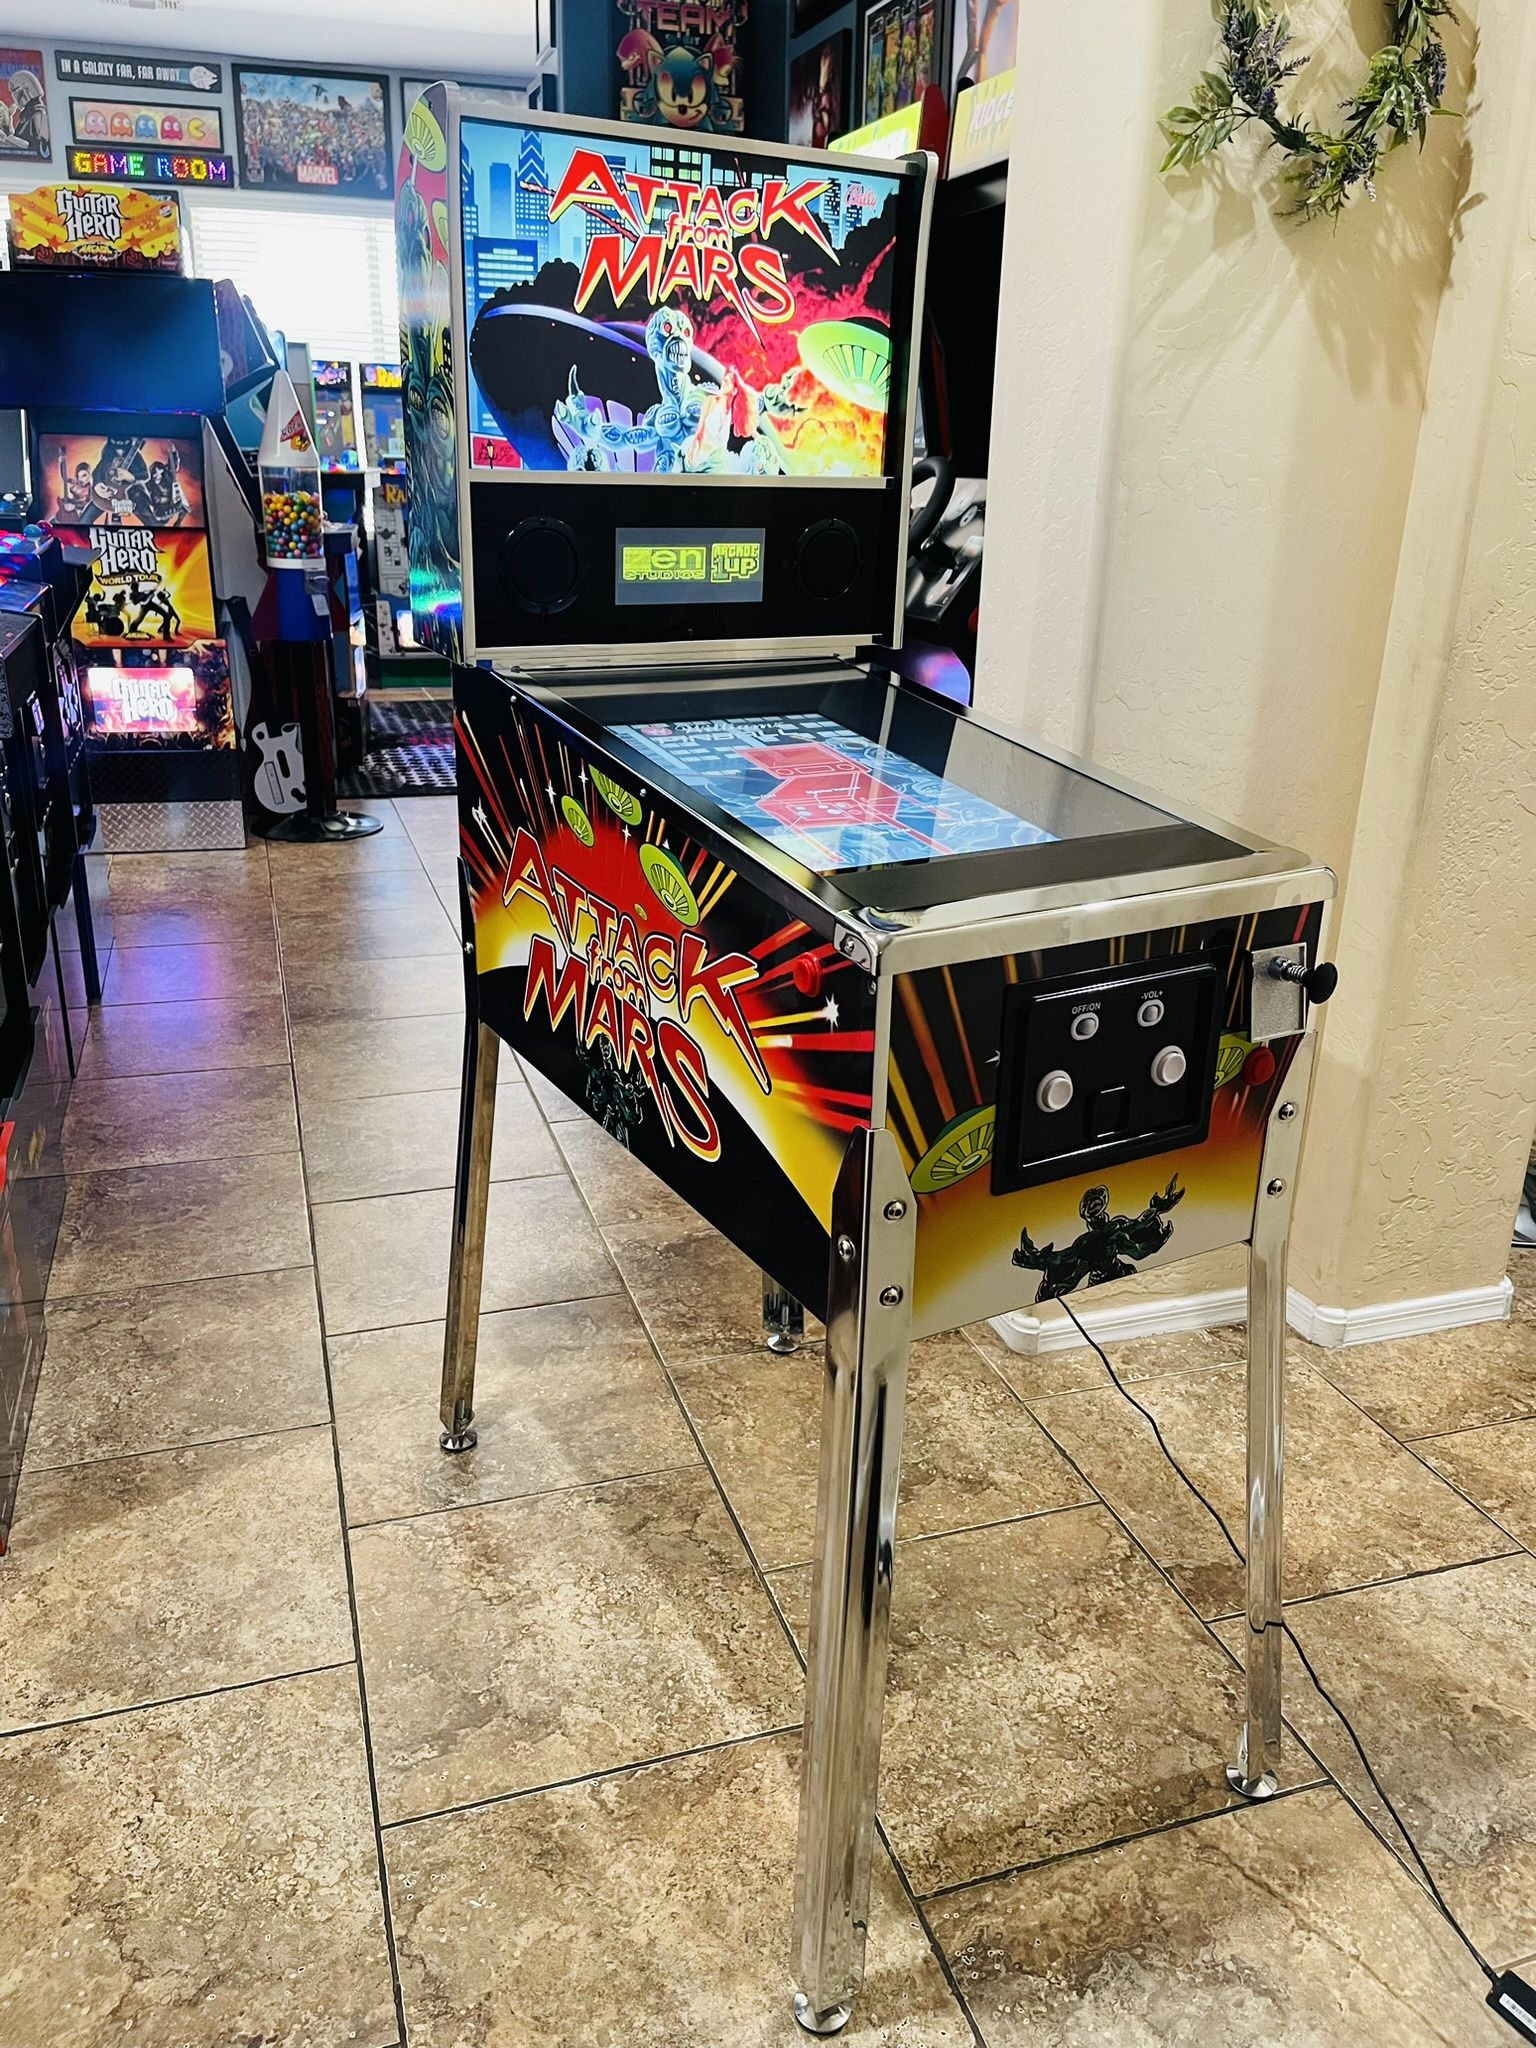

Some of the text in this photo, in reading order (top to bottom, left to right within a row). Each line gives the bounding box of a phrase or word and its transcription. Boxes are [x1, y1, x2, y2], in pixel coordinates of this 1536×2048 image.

[61, 58, 181, 82] IN A GALAXY FAR, FAR AWAY
[73, 152, 227, 181] GAME ROOM
[297, 162, 339, 185] MARVEL
[548, 147, 841, 266] ATTACK
[845, 183, 878, 208] Bally
[664, 211, 733, 251] from
[573, 233, 796, 349] MARS
[713, 544, 760, 558] ARCADE
[99, 573, 159, 585] WORLD TOUR
[623, 570, 707, 581] STUDIOS
[503, 827, 772, 1095] ATTACK
[588, 938, 650, 1019] from
[1071, 1001, 1102, 1015] OFF/ON
[524, 936, 722, 1162] MARS
